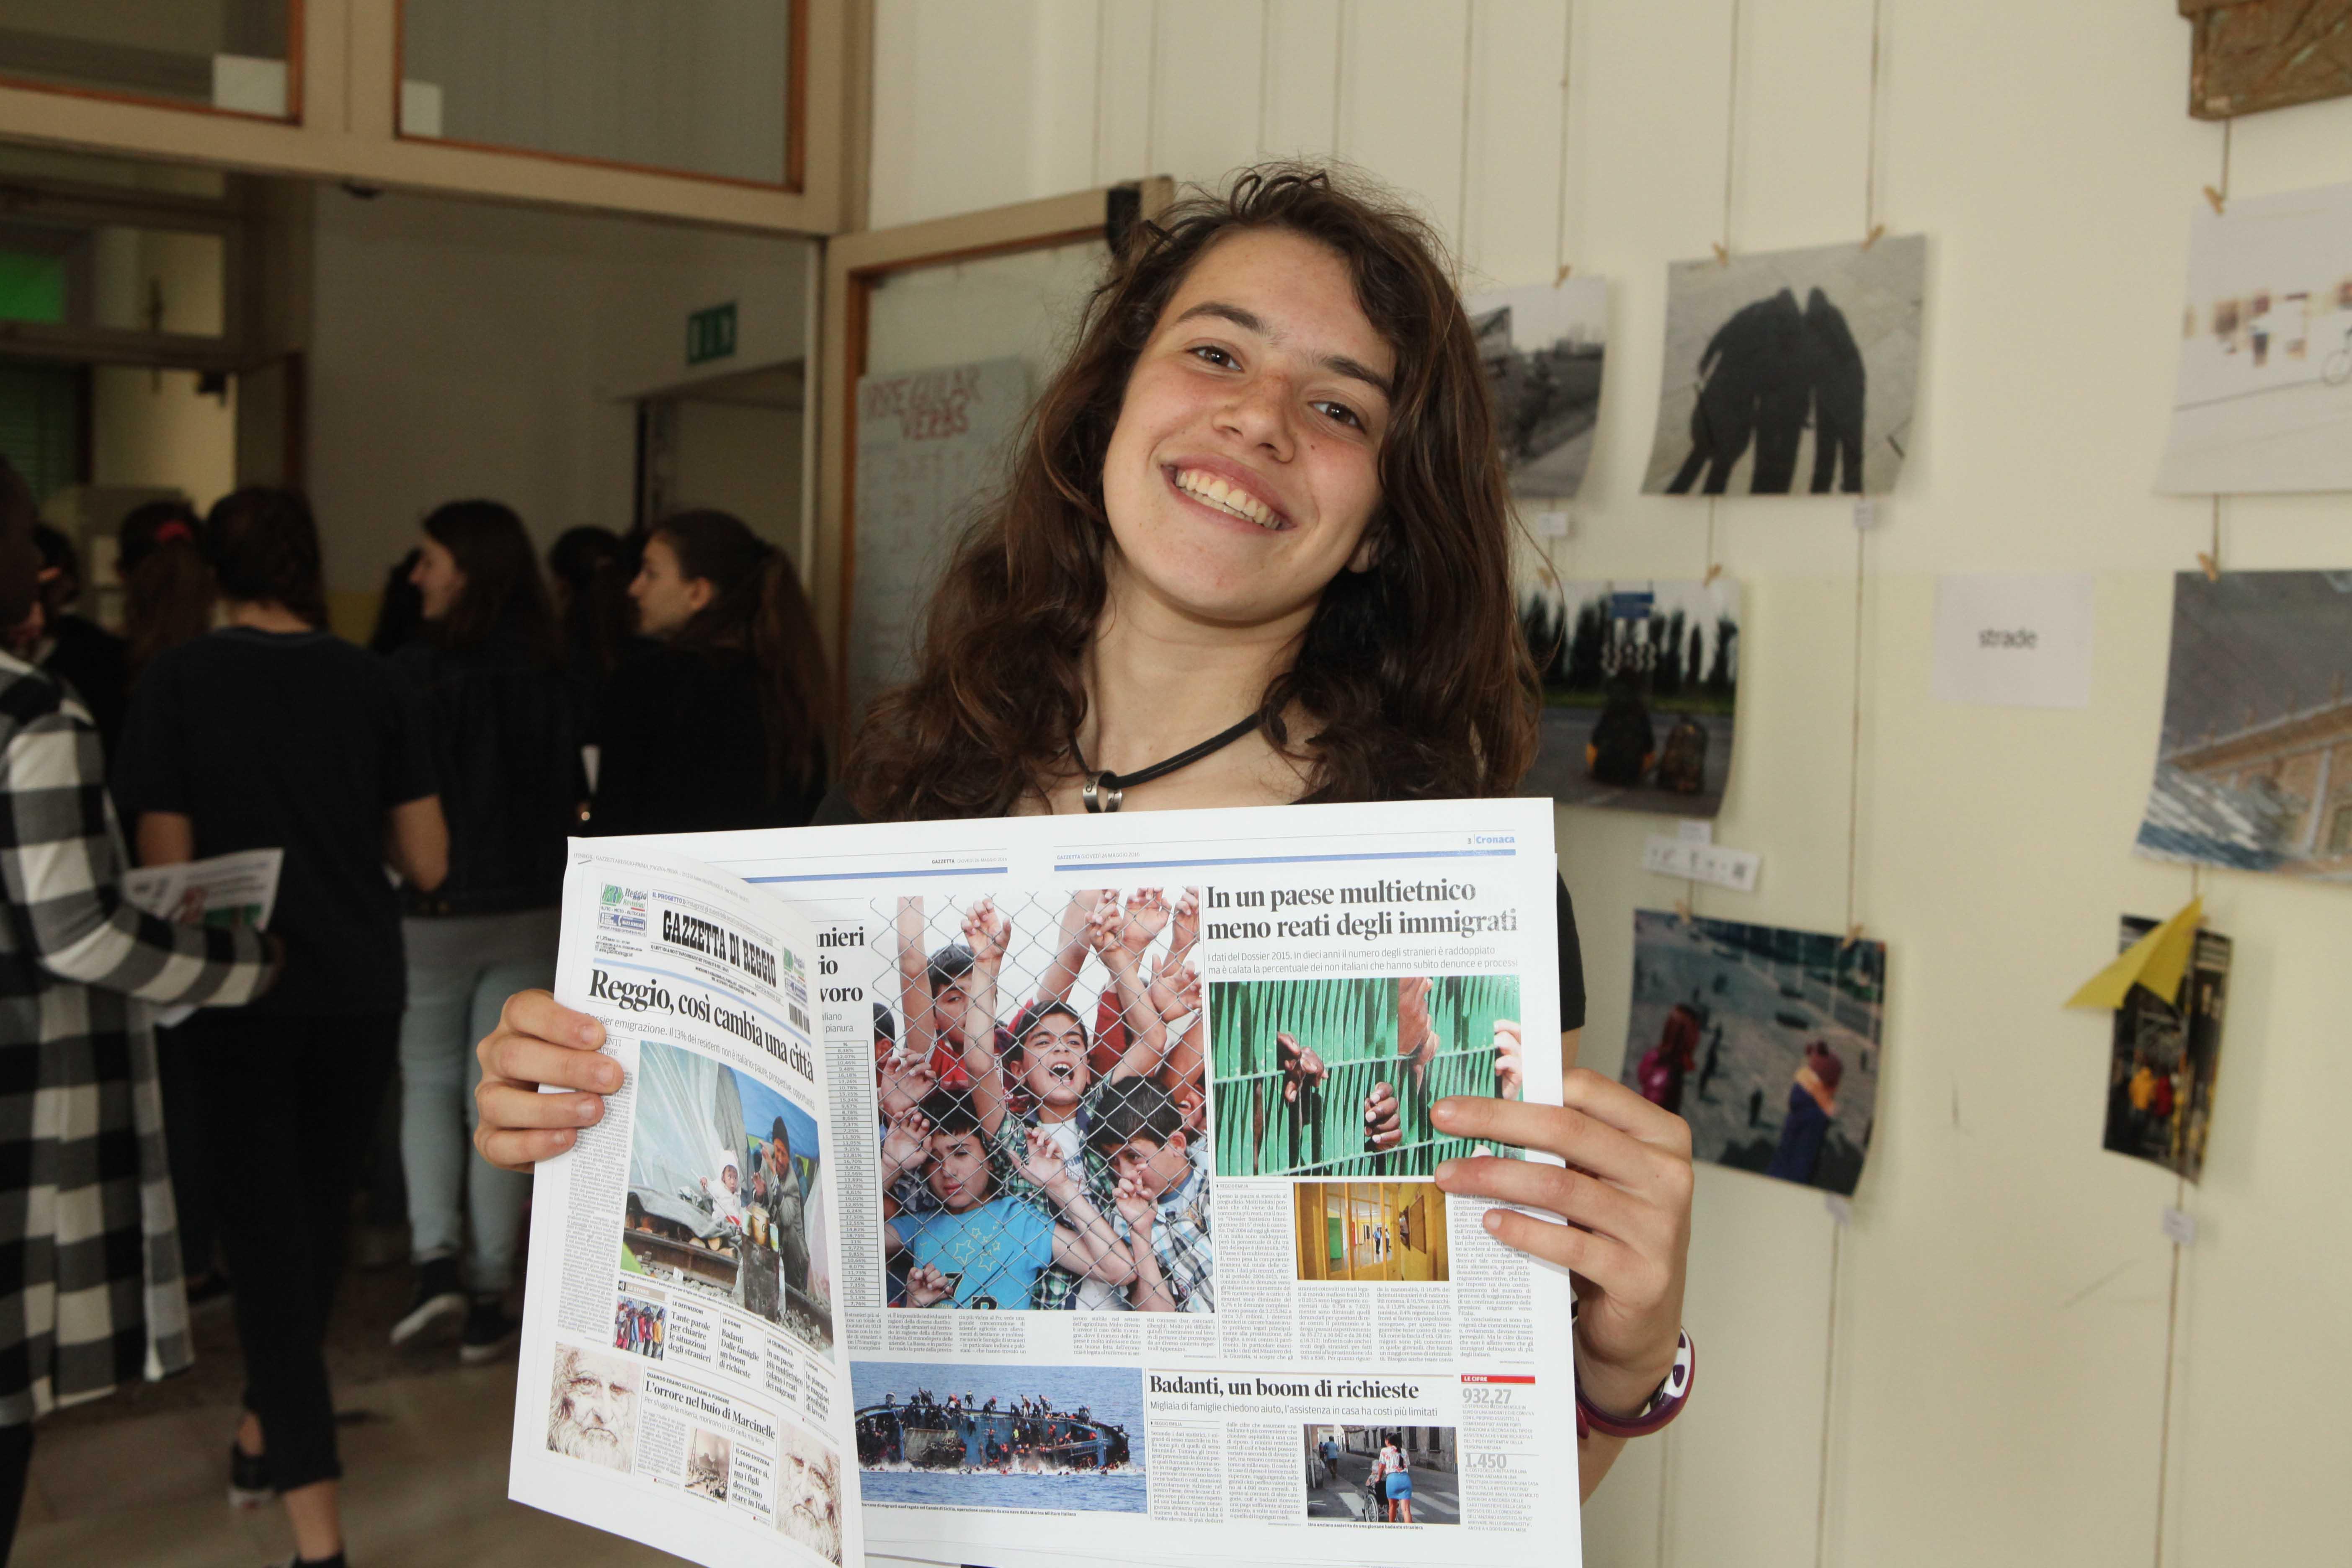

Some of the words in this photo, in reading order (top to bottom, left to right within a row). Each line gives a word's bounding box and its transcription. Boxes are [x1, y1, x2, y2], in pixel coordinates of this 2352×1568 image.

[1978, 628, 2037, 649] strade
[1081, 851, 1101, 859] GIOVEDÌ
[1206, 886, 1230, 908] In
[1235, 890, 1265, 907] un
[1270, 888, 1334, 911] paese
[1340, 878, 1475, 904] multietnico
[1207, 922, 1271, 939] meno
[1277, 913, 1330, 937] reati
[1336, 911, 1393, 940] degli
[1399, 908, 1516, 938] immigrati
[817, 926, 864, 947] nieri
[663, 910, 726, 961] GAZZETTA
[729, 933, 740, 967] DI
[742, 940, 776, 988] REGGIO
[1211, 952, 1226, 962] dati
[1227, 952, 1240, 962] del
[1240, 951, 1270, 962] Dossier
[1271, 951, 1292, 962] 2015.
[1294, 951, 1301, 960] In
[1303, 949, 1323, 959] dieci
[1322, 948, 1342, 959] anni
[1342, 949, 1346, 958] il
[1348, 950, 1380, 958] numero
[1381, 947, 1401, 958] degli
[1403, 946, 1438, 957] stranieri
[1445, 946, 1495, 956] raddoppiato
[819, 955, 838, 975] io
[1207, 966, 1220, 975] ma
[1228, 965, 1252, 975] calata
[1253, 964, 1260, 975] la
[1261, 963, 1310, 975] percentuale
[1310, 962, 1324, 972] dei
[1341, 961, 1368, 971] italiani
[1370, 961, 1384, 970] che
[1386, 961, 1411, 970] hanno
[1440, 959, 1475, 968] denunce
[588, 969, 674, 1015] Reggio,
[678, 994, 710, 1023] così
[714, 1007, 763, 1048] cambia
[765, 1032, 790, 1064] una
[790, 1042, 814, 1084] città
[825, 1024, 854, 1033] pianura
[614, 1019, 667, 1035] emigrazione.
[669, 1025, 673, 1037] Il
[674, 1028, 687, 1041] 13%
[687, 1032, 696, 1044] dei
[697, 1038, 721, 1054] residenti
[722, 1047, 731, 1058] non
[736, 1051, 754, 1069] italiano:
[678, 1302, 704, 1315] DEFINIZIONI
[671, 1310, 690, 1323] Tante
[691, 1319, 710, 1331] parole
[669, 1332, 675, 1342] le
[676, 1335, 706, 1350] situazioni
[670, 1323, 681, 1336] per
[682, 1326, 707, 1340] chiarire
[722, 1328, 743, 1344] Badanti
[668, 1341, 683, 1354] degli
[684, 1349, 711, 1363] stranieri
[720, 1351, 728, 1359] un
[729, 1351, 745, 1366] boom
[721, 1338, 736, 1351] Dalle
[737, 1345, 759, 1361] famiglie
[767, 1348, 772, 1358] In
[773, 1353, 780, 1362] un
[781, 1357, 794, 1369] paese
[719, 1360, 725, 1368] di
[726, 1363, 750, 1378] richieste
[766, 1360, 775, 1372] più
[776, 1364, 803, 1386] multietnico
[766, 1371, 783, 1385] calano
[786, 1381, 797, 1392] reati
[766, 1379, 774, 1390] dei
[774, 1385, 796, 1402] migranti
[1150, 1375, 1224, 1397] Badanti,
[1228, 1382, 1252, 1395] un
[1256, 1378, 1310, 1397] boom
[1314, 1379, 1332, 1397] di
[1337, 1380, 1419, 1398] richieste
[1462, 1388, 1511, 1408] 932,27
[686, 1396, 699, 1408] nel
[701, 1398, 720, 1416] buio
[722, 1407, 730, 1420] di
[732, 1411, 775, 1439] Marcinelle
[1150, 1401, 1180, 1411] Migliaia
[1181, 1401, 1188, 1411] di
[1190, 1401, 1222, 1413] famiglie
[1223, 1403, 1259, 1413] chiedono
[1261, 1404, 1283, 1414] aiuto,
[1332, 1405, 1339, 1415] in
[1361, 1406, 1372, 1415] ha
[1373, 1406, 1392, 1416] costi
[1394, 1406, 1407, 1416] più
[1408, 1407, 1437, 1416] limitati
[735, 1457, 762, 1475] Lavorare
[1465, 1454, 1507, 1469] 1.450
[734, 1470, 743, 1479] ma
[748, 1474, 759, 1486] figli
[733, 1480, 762, 1498] dovevano
[732, 1493, 747, 1504] stare
[748, 1497, 754, 1507] in
[755, 1501, 770, 1514] Italia
